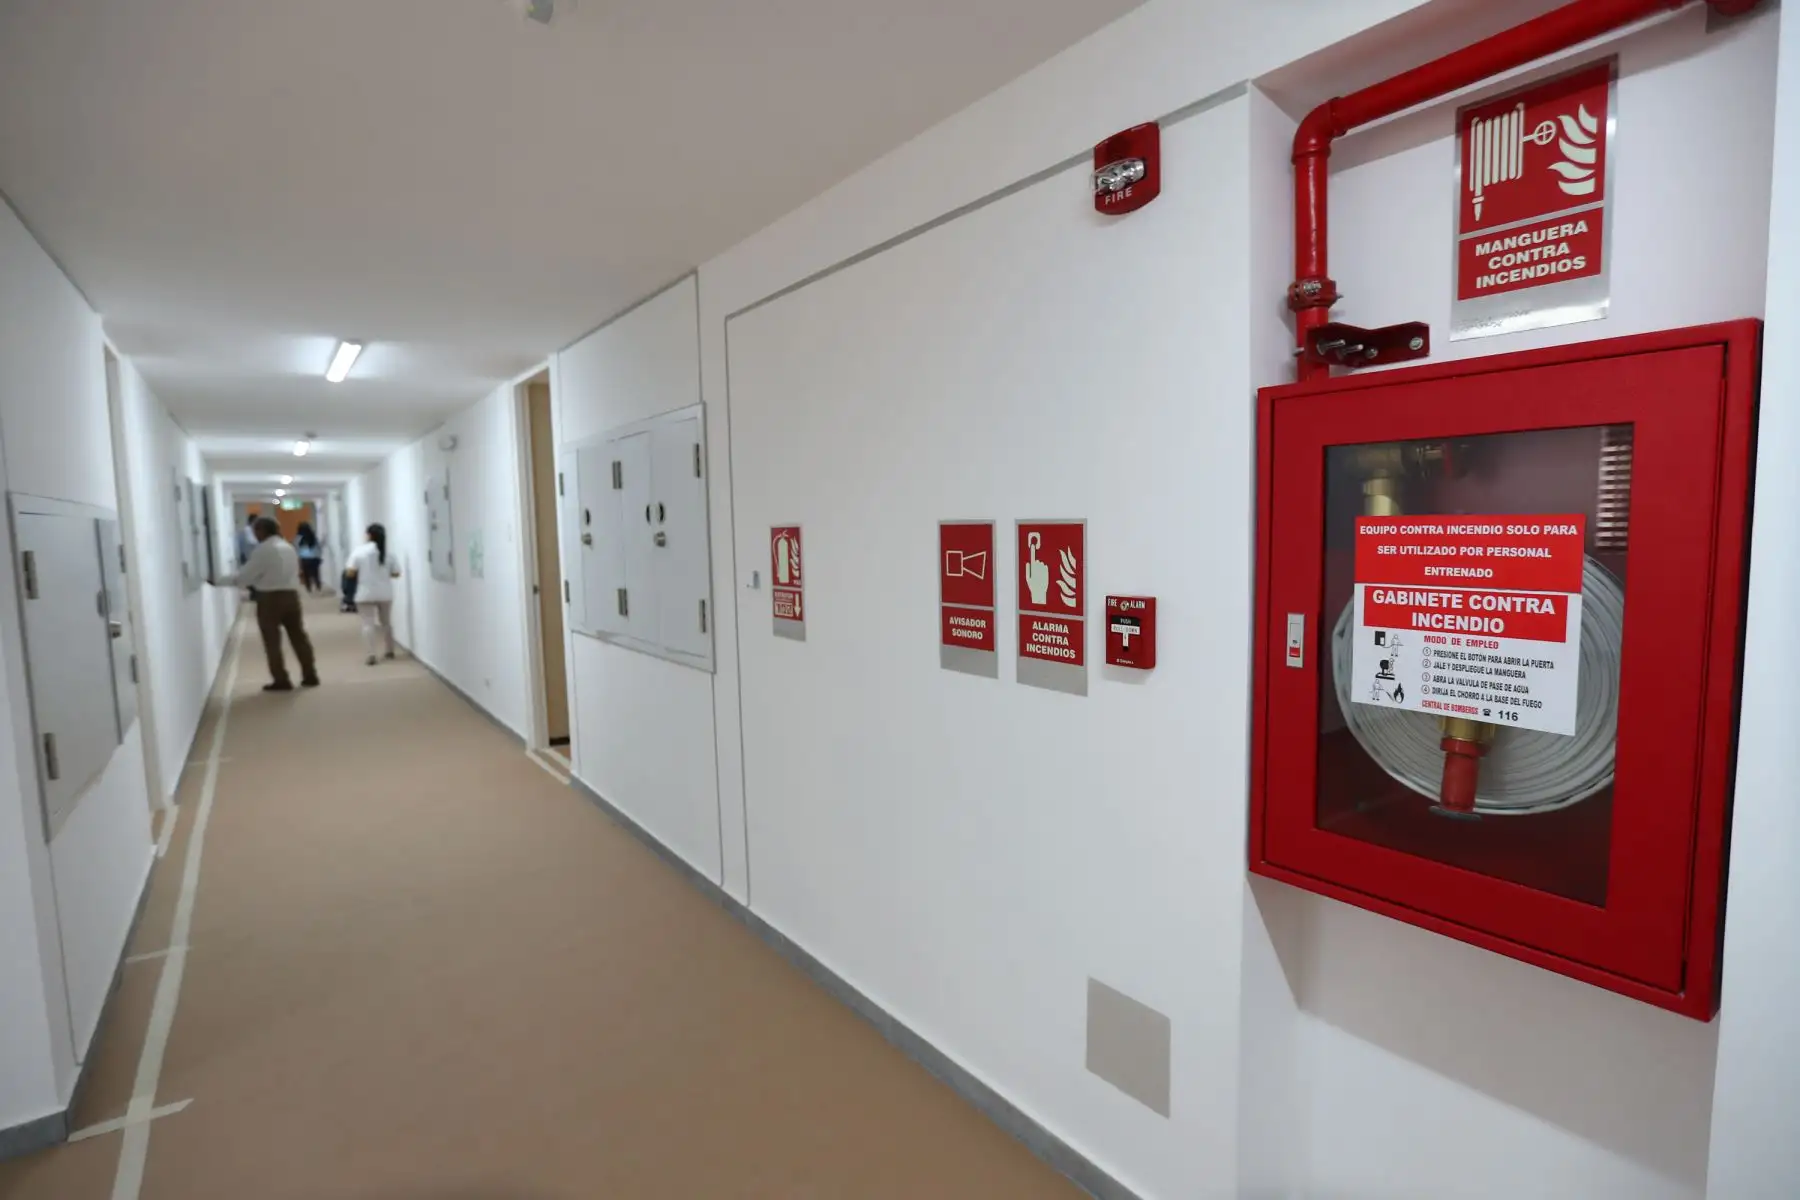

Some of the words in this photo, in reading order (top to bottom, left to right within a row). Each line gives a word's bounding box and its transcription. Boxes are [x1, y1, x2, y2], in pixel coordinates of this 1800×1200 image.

[1105, 187, 1132, 205] FIRE
[1475, 220, 1588, 256] MANGUERA
[1488, 242, 1570, 269] CONTRA
[1475, 256, 1586, 289] INCENDIOS
[1360, 525, 1397, 534] EQUIPO
[1400, 525, 1444, 534] CONTRA
[1447, 525, 1502, 534] INCENDIO
[1506, 525, 1540, 534] SOLO
[1544, 525, 1578, 535] PARA
[1377, 546, 1396, 554] SER
[1400, 546, 1456, 556] UTILIZADO
[1460, 546, 1483, 556] POR
[1486, 547, 1552, 558] PERSONAL
[1424, 566, 1493, 578] ENTRENADO
[1108, 598, 1117, 607] FIRE
[1130, 600, 1145, 609] ALARM
[1372, 590, 1463, 608] GABINETE
[1468, 594, 1556, 614] CONTRA
[950, 616, 986, 628] AVISADOR
[1032, 621, 1069, 634] ALARMA
[1412, 612, 1504, 634] INCENDIO
[952, 628, 983, 640] SONORO
[1032, 632, 1069, 646] CONTRA
[1424, 635, 1446, 644] MODO
[1452, 637, 1462, 646] DE
[1466, 638, 1498, 650] EMPLEO
[1026, 643, 1076, 659] INCENDIOS
[1434, 650, 1459, 660] PRESIONE
[1460, 652, 1467, 660] EL
[1468, 653, 1486, 662] BOTON
[1488, 654, 1502, 664] PARA
[1503, 656, 1520, 666] ABRIR
[1522, 658, 1530, 666] LA
[1531, 660, 1554, 669] PUERTA
[1433, 661, 1446, 670] JALE
[1452, 664, 1484, 674] DESPLIEGUE
[1486, 666, 1492, 675] LA
[1494, 668, 1526, 678] MANGUERA
[1432, 675, 1446, 684] ABRA
[1448, 676, 1454, 684] LA
[1456, 678, 1480, 688] VALVULA
[1481, 680, 1488, 689] DE
[1489, 682, 1503, 691] PASE
[1504, 684, 1512, 692] DE
[1513, 685, 1529, 694] AGUA
[1432, 687, 1448, 696] DIRIJA
[1458, 690, 1480, 700] CHORRO
[1494, 695, 1509, 704] BASE
[1510, 697, 1521, 706] DEL
[1522, 699, 1542, 709] FUEGO
[1422, 700, 1442, 710] CENTRAL
[1451, 704, 1478, 714] BOMBEROS
[1498, 710, 1519, 721] 116
